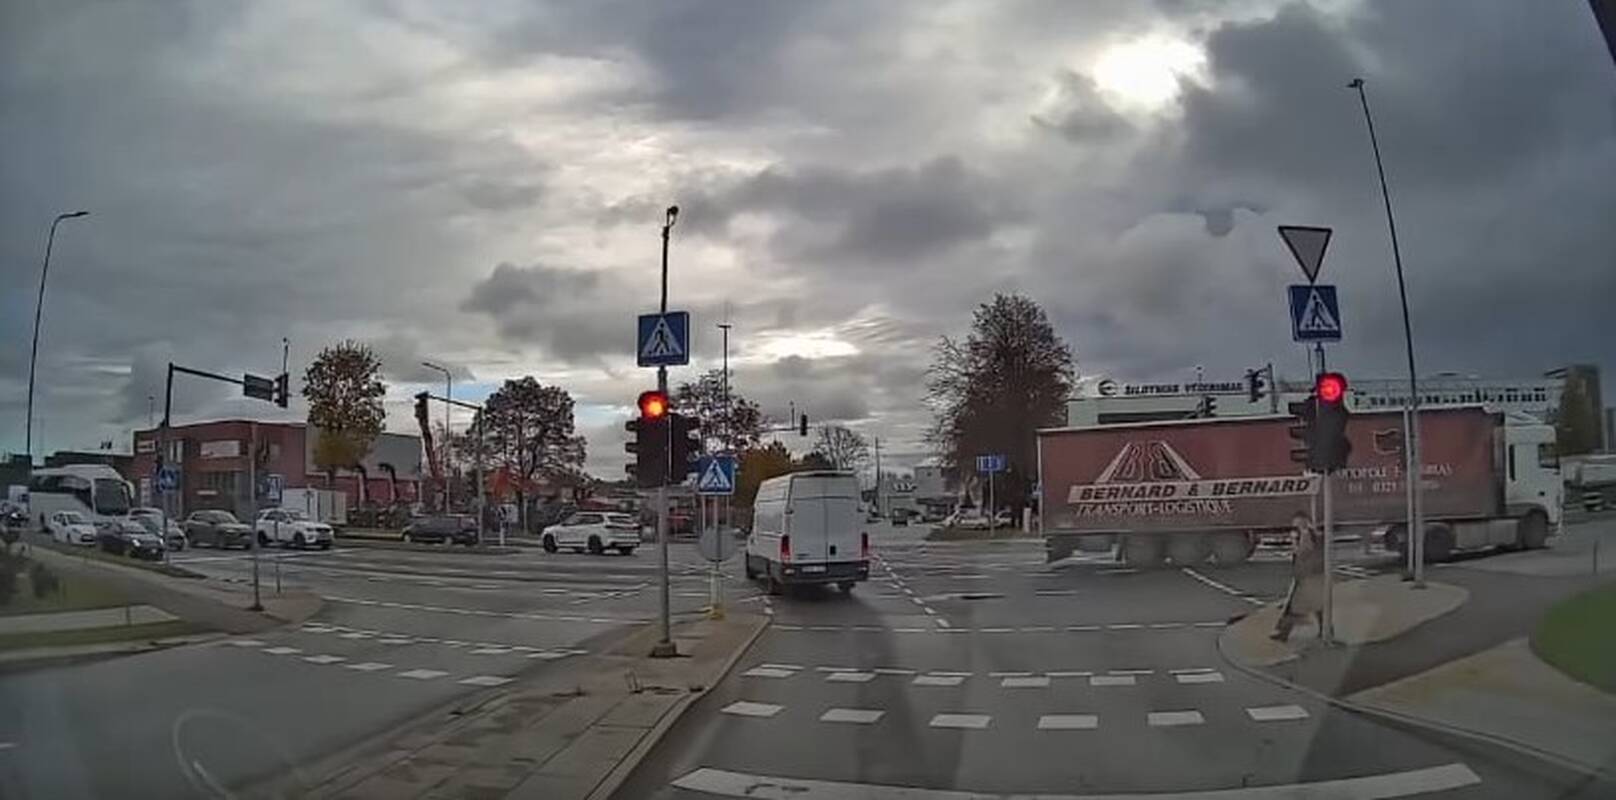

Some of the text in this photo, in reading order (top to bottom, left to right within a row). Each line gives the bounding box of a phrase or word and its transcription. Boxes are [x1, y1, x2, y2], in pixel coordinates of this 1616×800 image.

[1079, 480, 1309, 501] BERNARD & BERNARD
[1075, 500, 1234, 517] TRANSPORT-LOGISTIQUE
